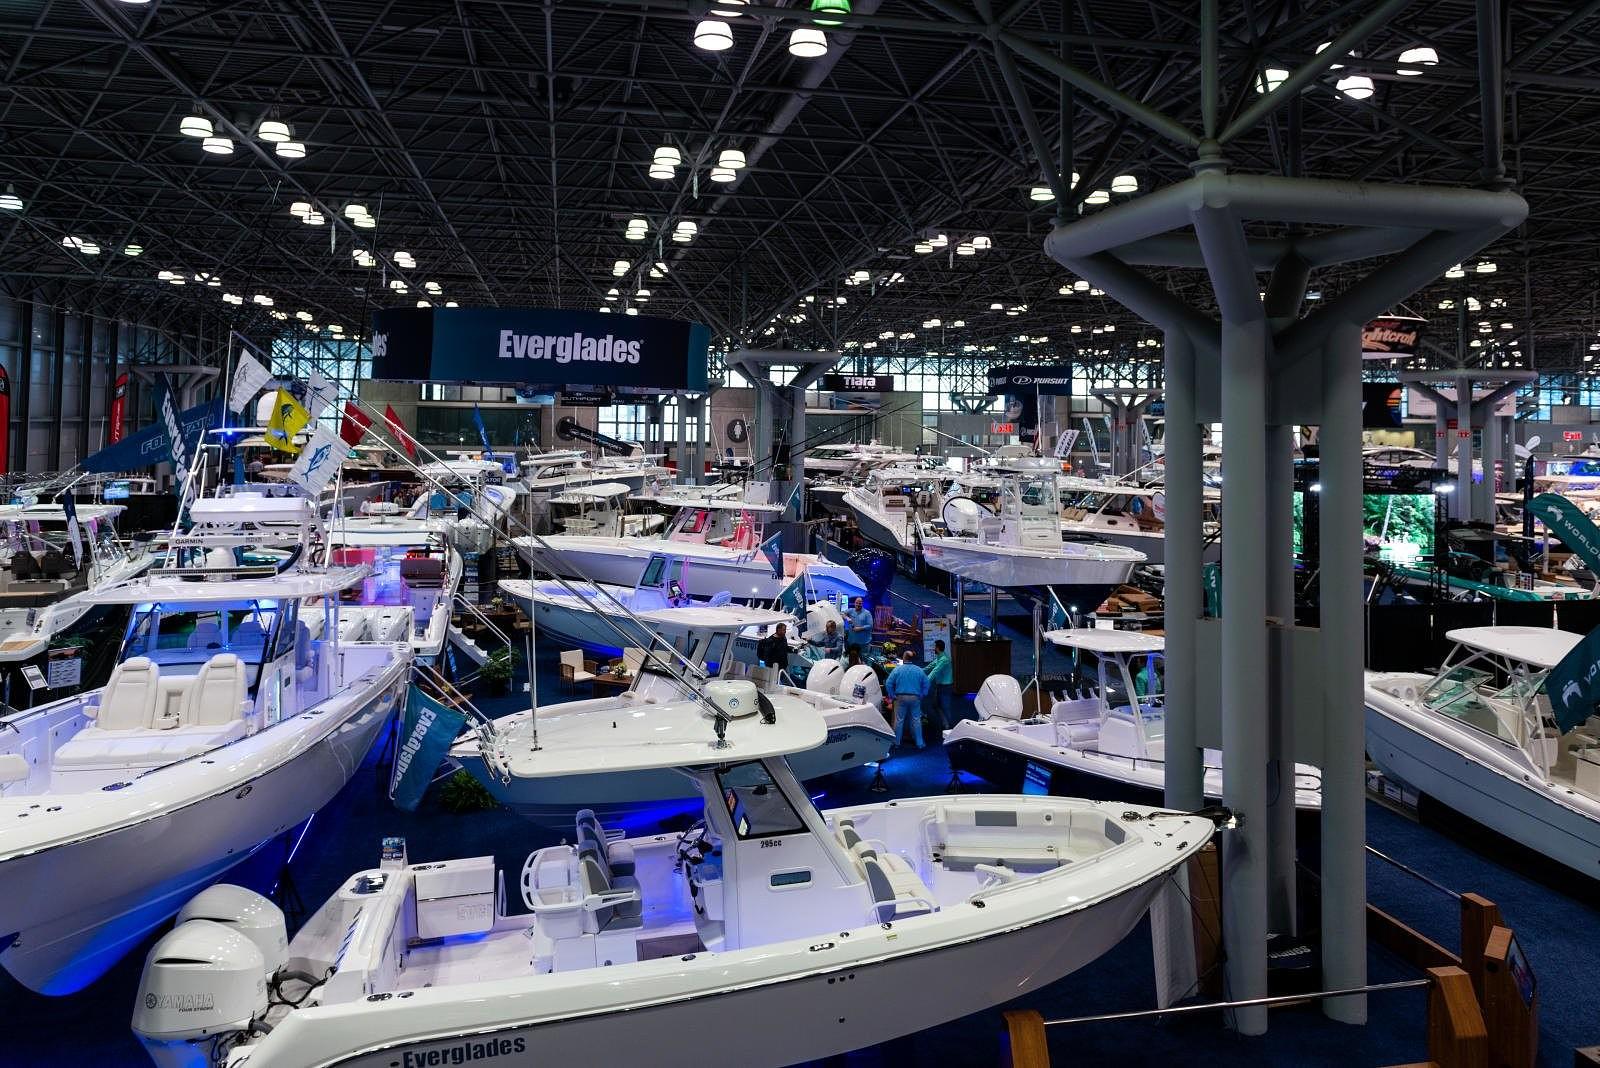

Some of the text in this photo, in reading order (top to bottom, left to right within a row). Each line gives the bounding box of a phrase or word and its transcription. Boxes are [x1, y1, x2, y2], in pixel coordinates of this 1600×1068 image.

[498, 329, 641, 364] Everglades
[1033, 377, 1069, 385] PURSUIT
[760, 839, 782, 848] 295cc
[159, 992, 215, 1009] YAMAHA
[402, 1037, 526, 1068] Everglades
